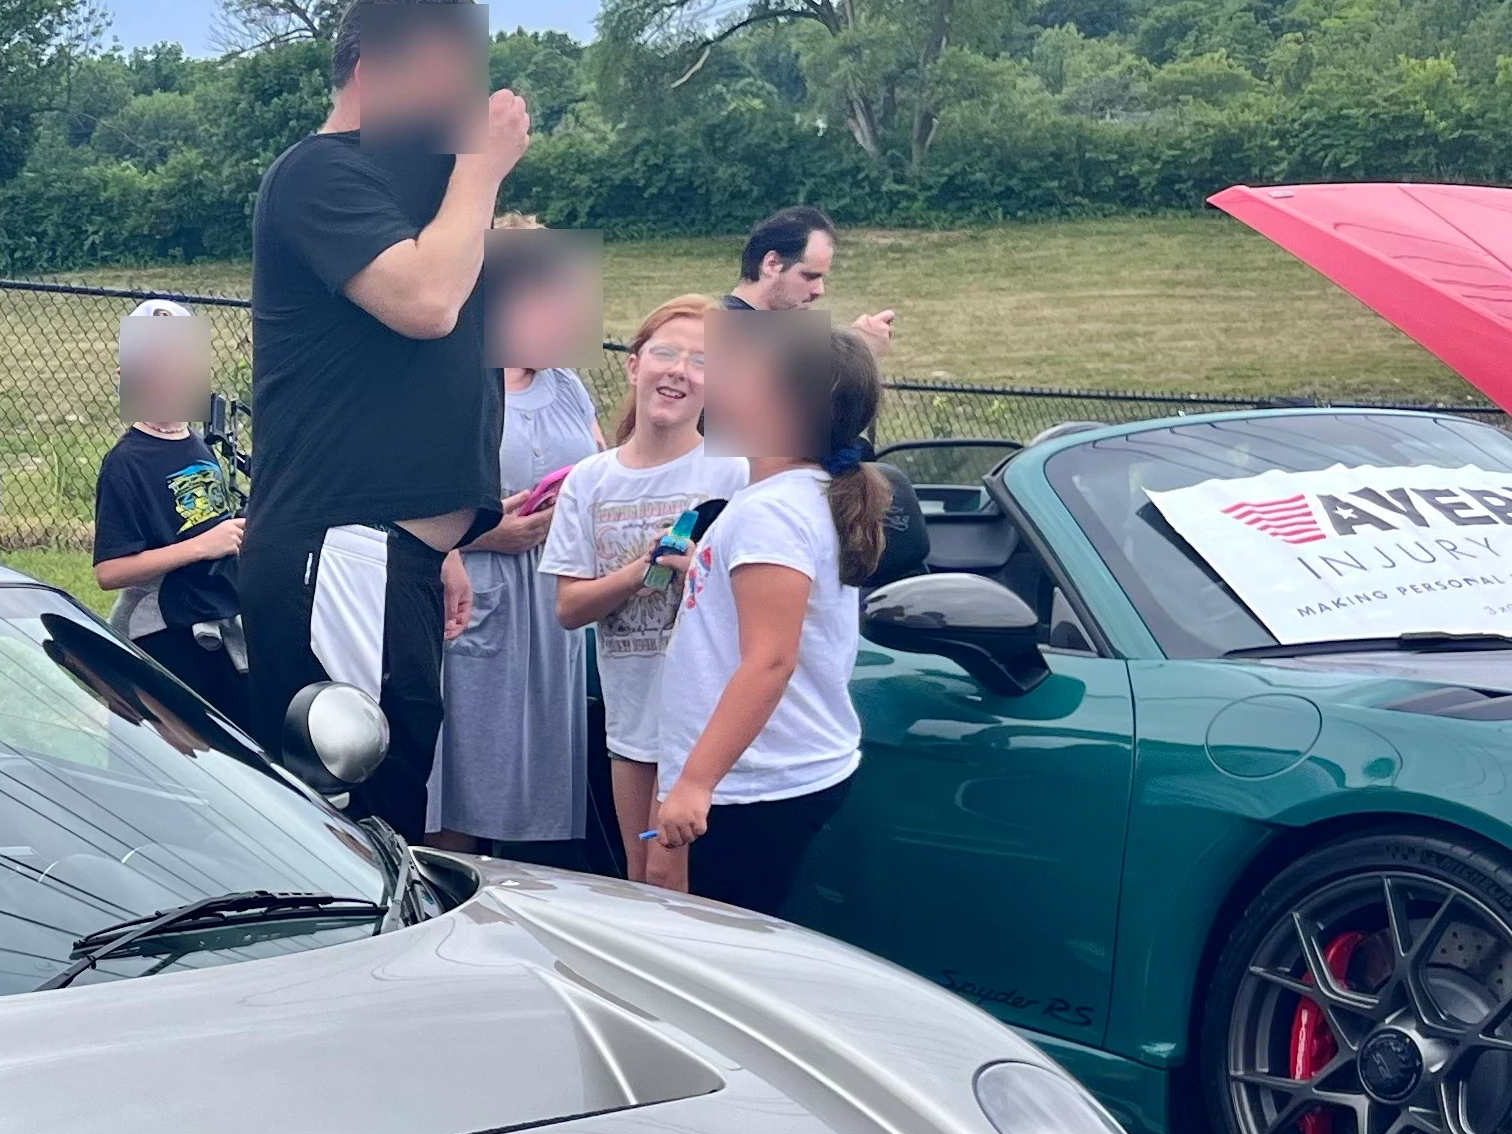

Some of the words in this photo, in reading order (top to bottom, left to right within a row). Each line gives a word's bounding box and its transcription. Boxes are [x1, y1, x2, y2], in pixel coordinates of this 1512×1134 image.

[1316, 486, 1512, 537] AVER
[1297, 537, 1501, 580] INJURY
[1296, 590, 1389, 618] MAKING
[1396, 574, 1506, 596] PERSONAL
[941, 969, 1039, 1009] Spyder
[1042, 997, 1095, 1027] RS
